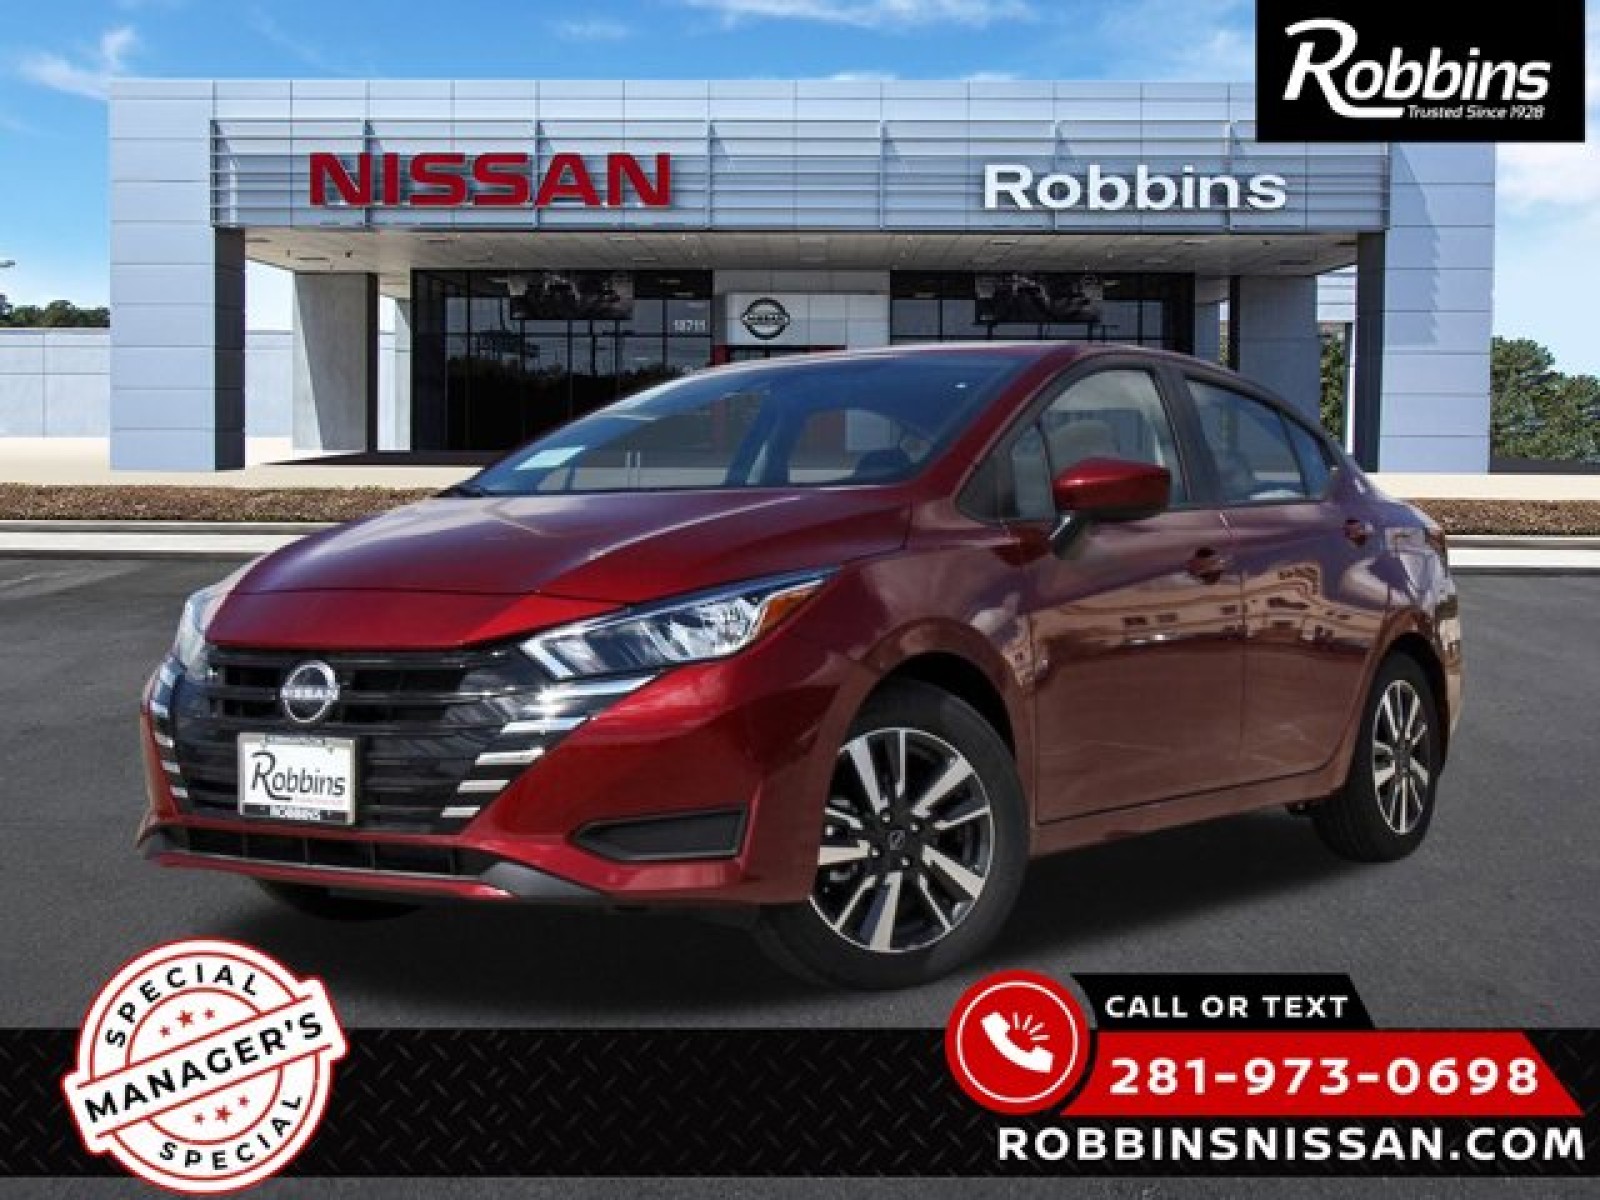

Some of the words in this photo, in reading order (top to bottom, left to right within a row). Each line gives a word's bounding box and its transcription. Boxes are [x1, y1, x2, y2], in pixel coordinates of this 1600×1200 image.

[309, 152, 671, 207] NISSAN
[984, 164, 1287, 210] Robbins
[252, 751, 346, 801] Robbins
